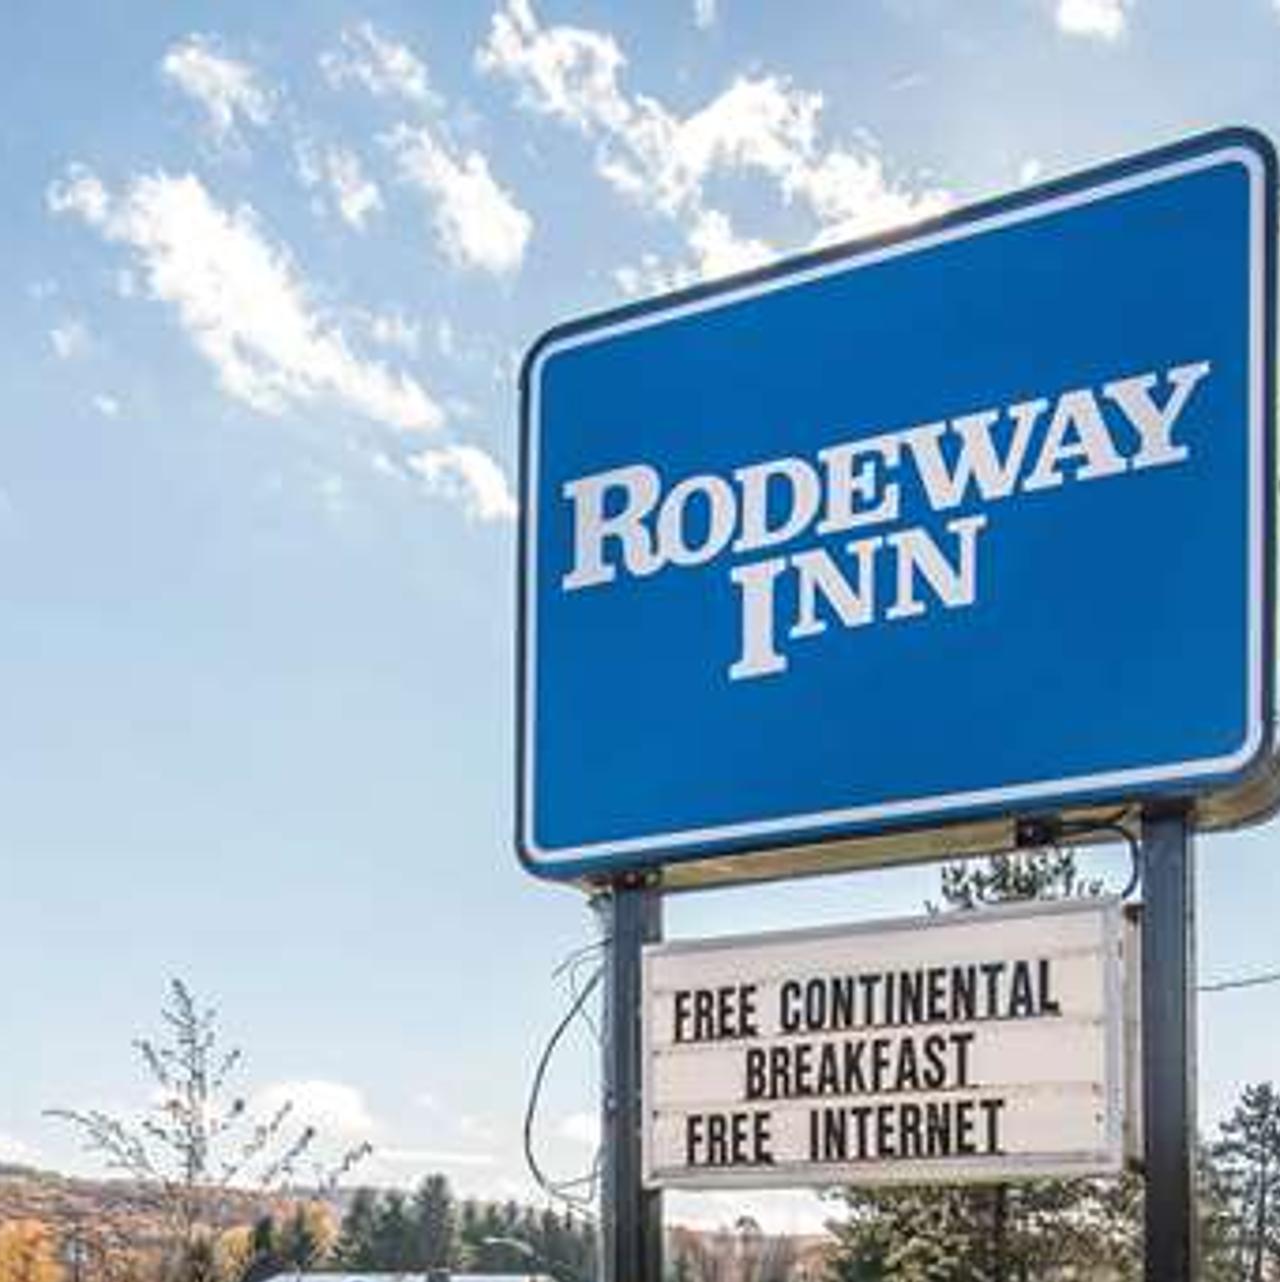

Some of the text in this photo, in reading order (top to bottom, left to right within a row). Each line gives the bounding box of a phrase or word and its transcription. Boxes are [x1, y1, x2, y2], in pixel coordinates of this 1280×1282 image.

[561, 361, 1211, 591] RODEWAY
[728, 515, 987, 681] INN
[673, 959, 1062, 1042] FREE CONTINENTAL
[744, 1032, 977, 1100] BREAKFAST
[685, 1099, 1006, 1166] FREE INTERNET
